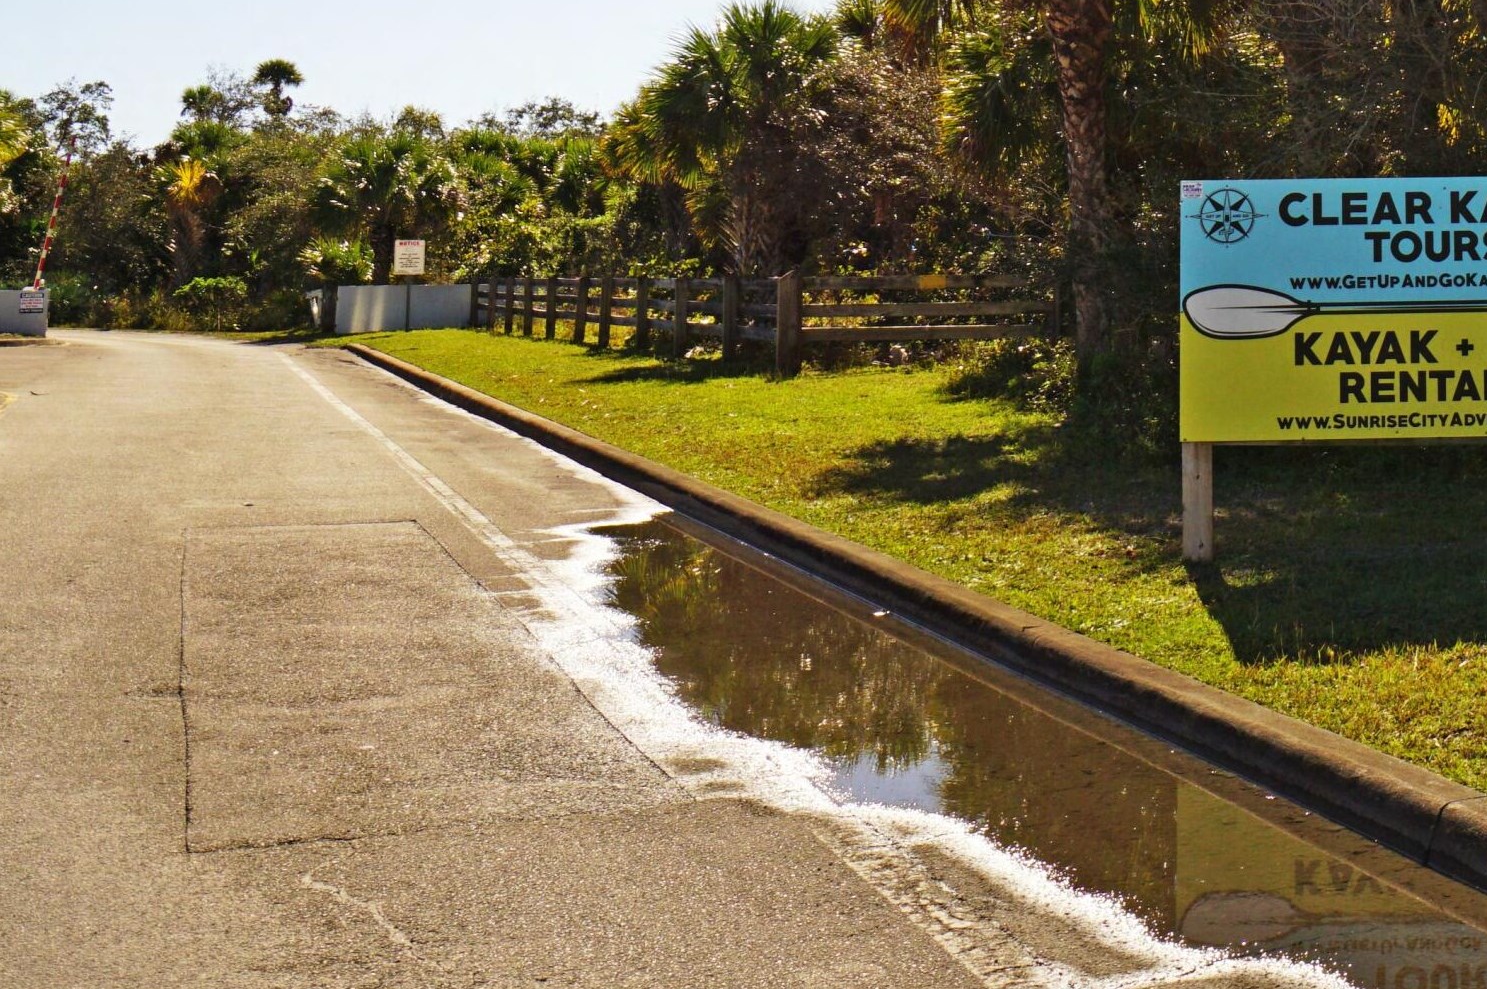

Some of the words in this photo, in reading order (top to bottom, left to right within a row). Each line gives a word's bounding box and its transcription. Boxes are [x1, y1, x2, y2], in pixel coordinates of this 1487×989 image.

[1278, 192, 1435, 227] CLEAR
[1294, 329, 1439, 367] KAYAK
[1455, 338, 1475, 357] +
